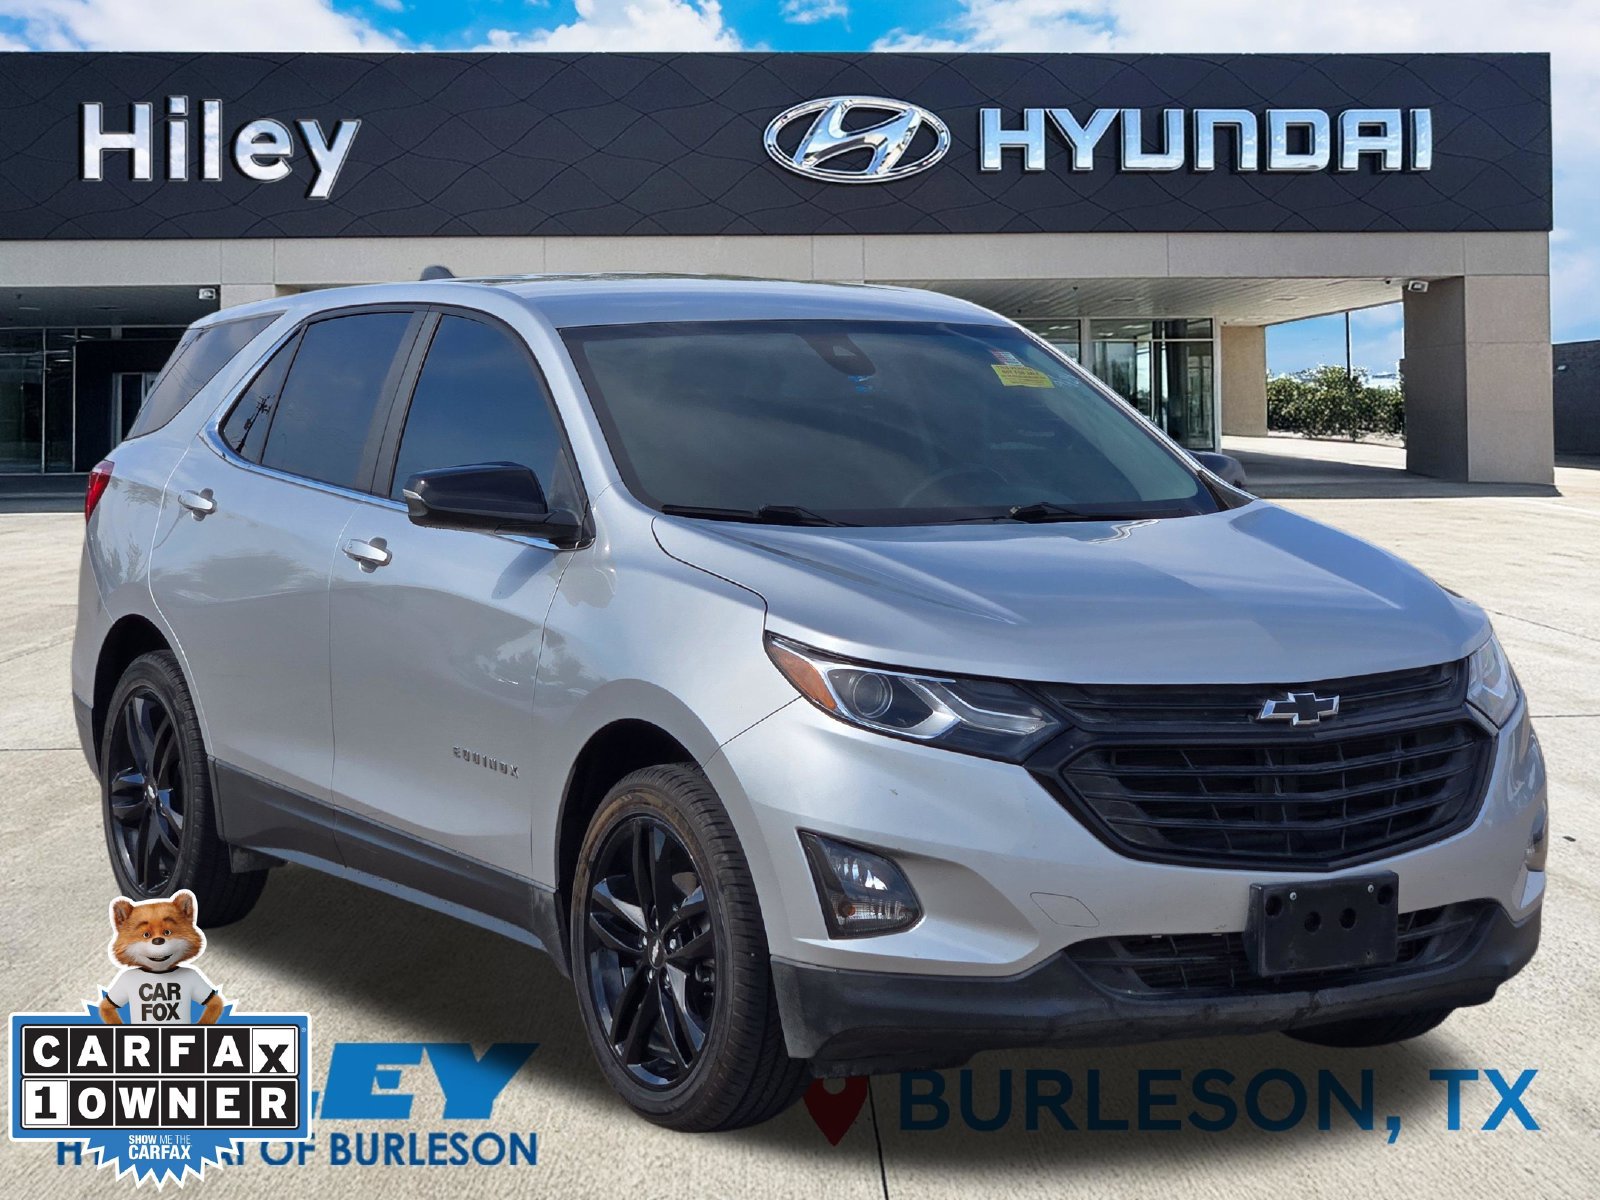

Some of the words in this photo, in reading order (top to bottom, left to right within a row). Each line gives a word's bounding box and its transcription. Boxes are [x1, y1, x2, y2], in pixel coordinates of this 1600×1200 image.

[80, 95, 361, 200] Hiley
[978, 107, 1433, 172] HYUNDAI
[453, 746, 519, 780] EQUINOX
